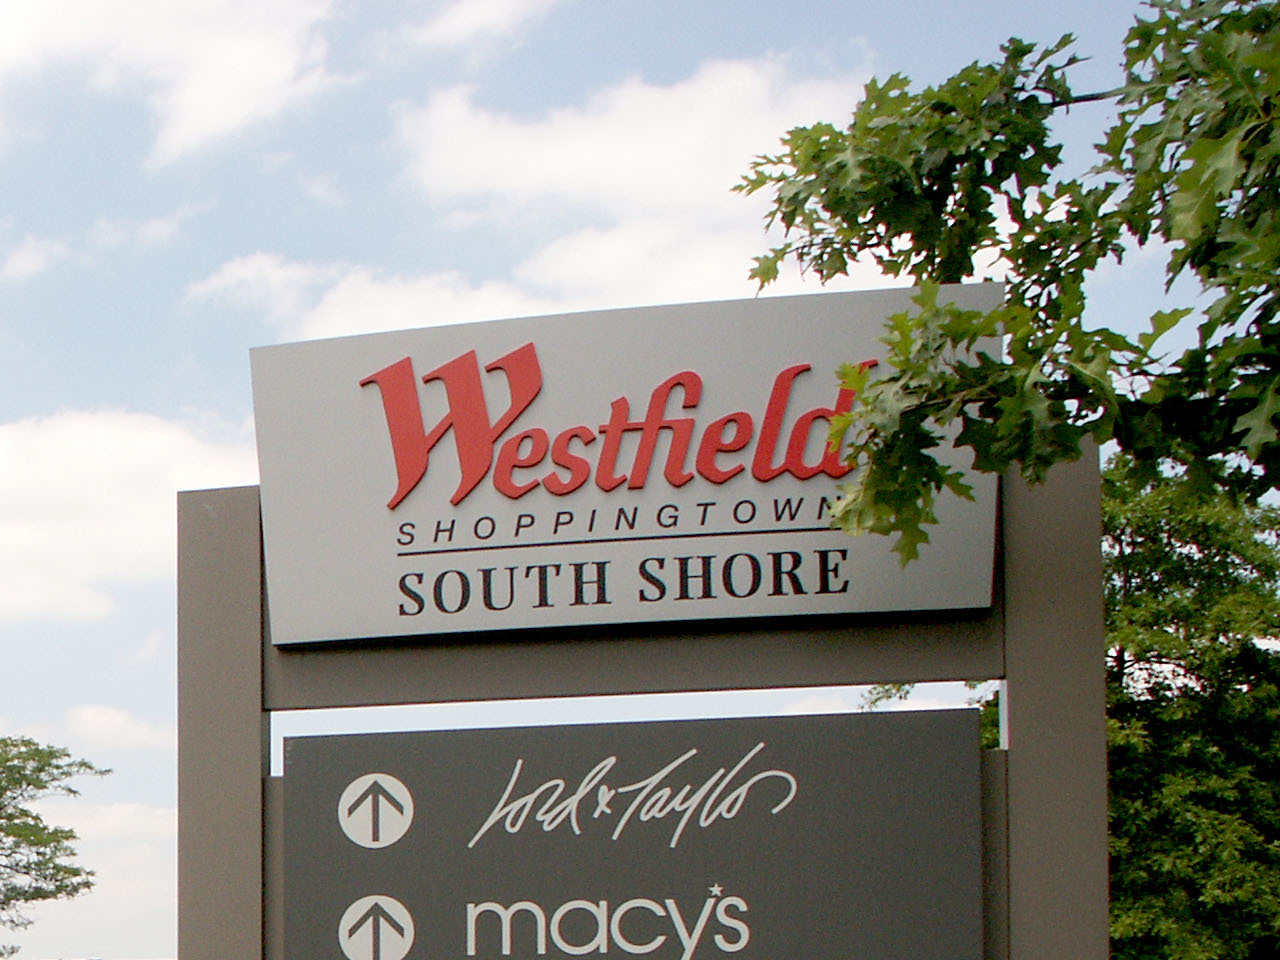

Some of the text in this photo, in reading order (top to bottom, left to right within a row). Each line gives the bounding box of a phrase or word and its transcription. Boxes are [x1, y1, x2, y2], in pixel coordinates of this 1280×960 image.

[360, 342, 878, 509] Westfield
[398, 548, 851, 616] SOUTH SHORE
[469, 755, 616, 848] Lord
[612, 741, 798, 848] Taylor
